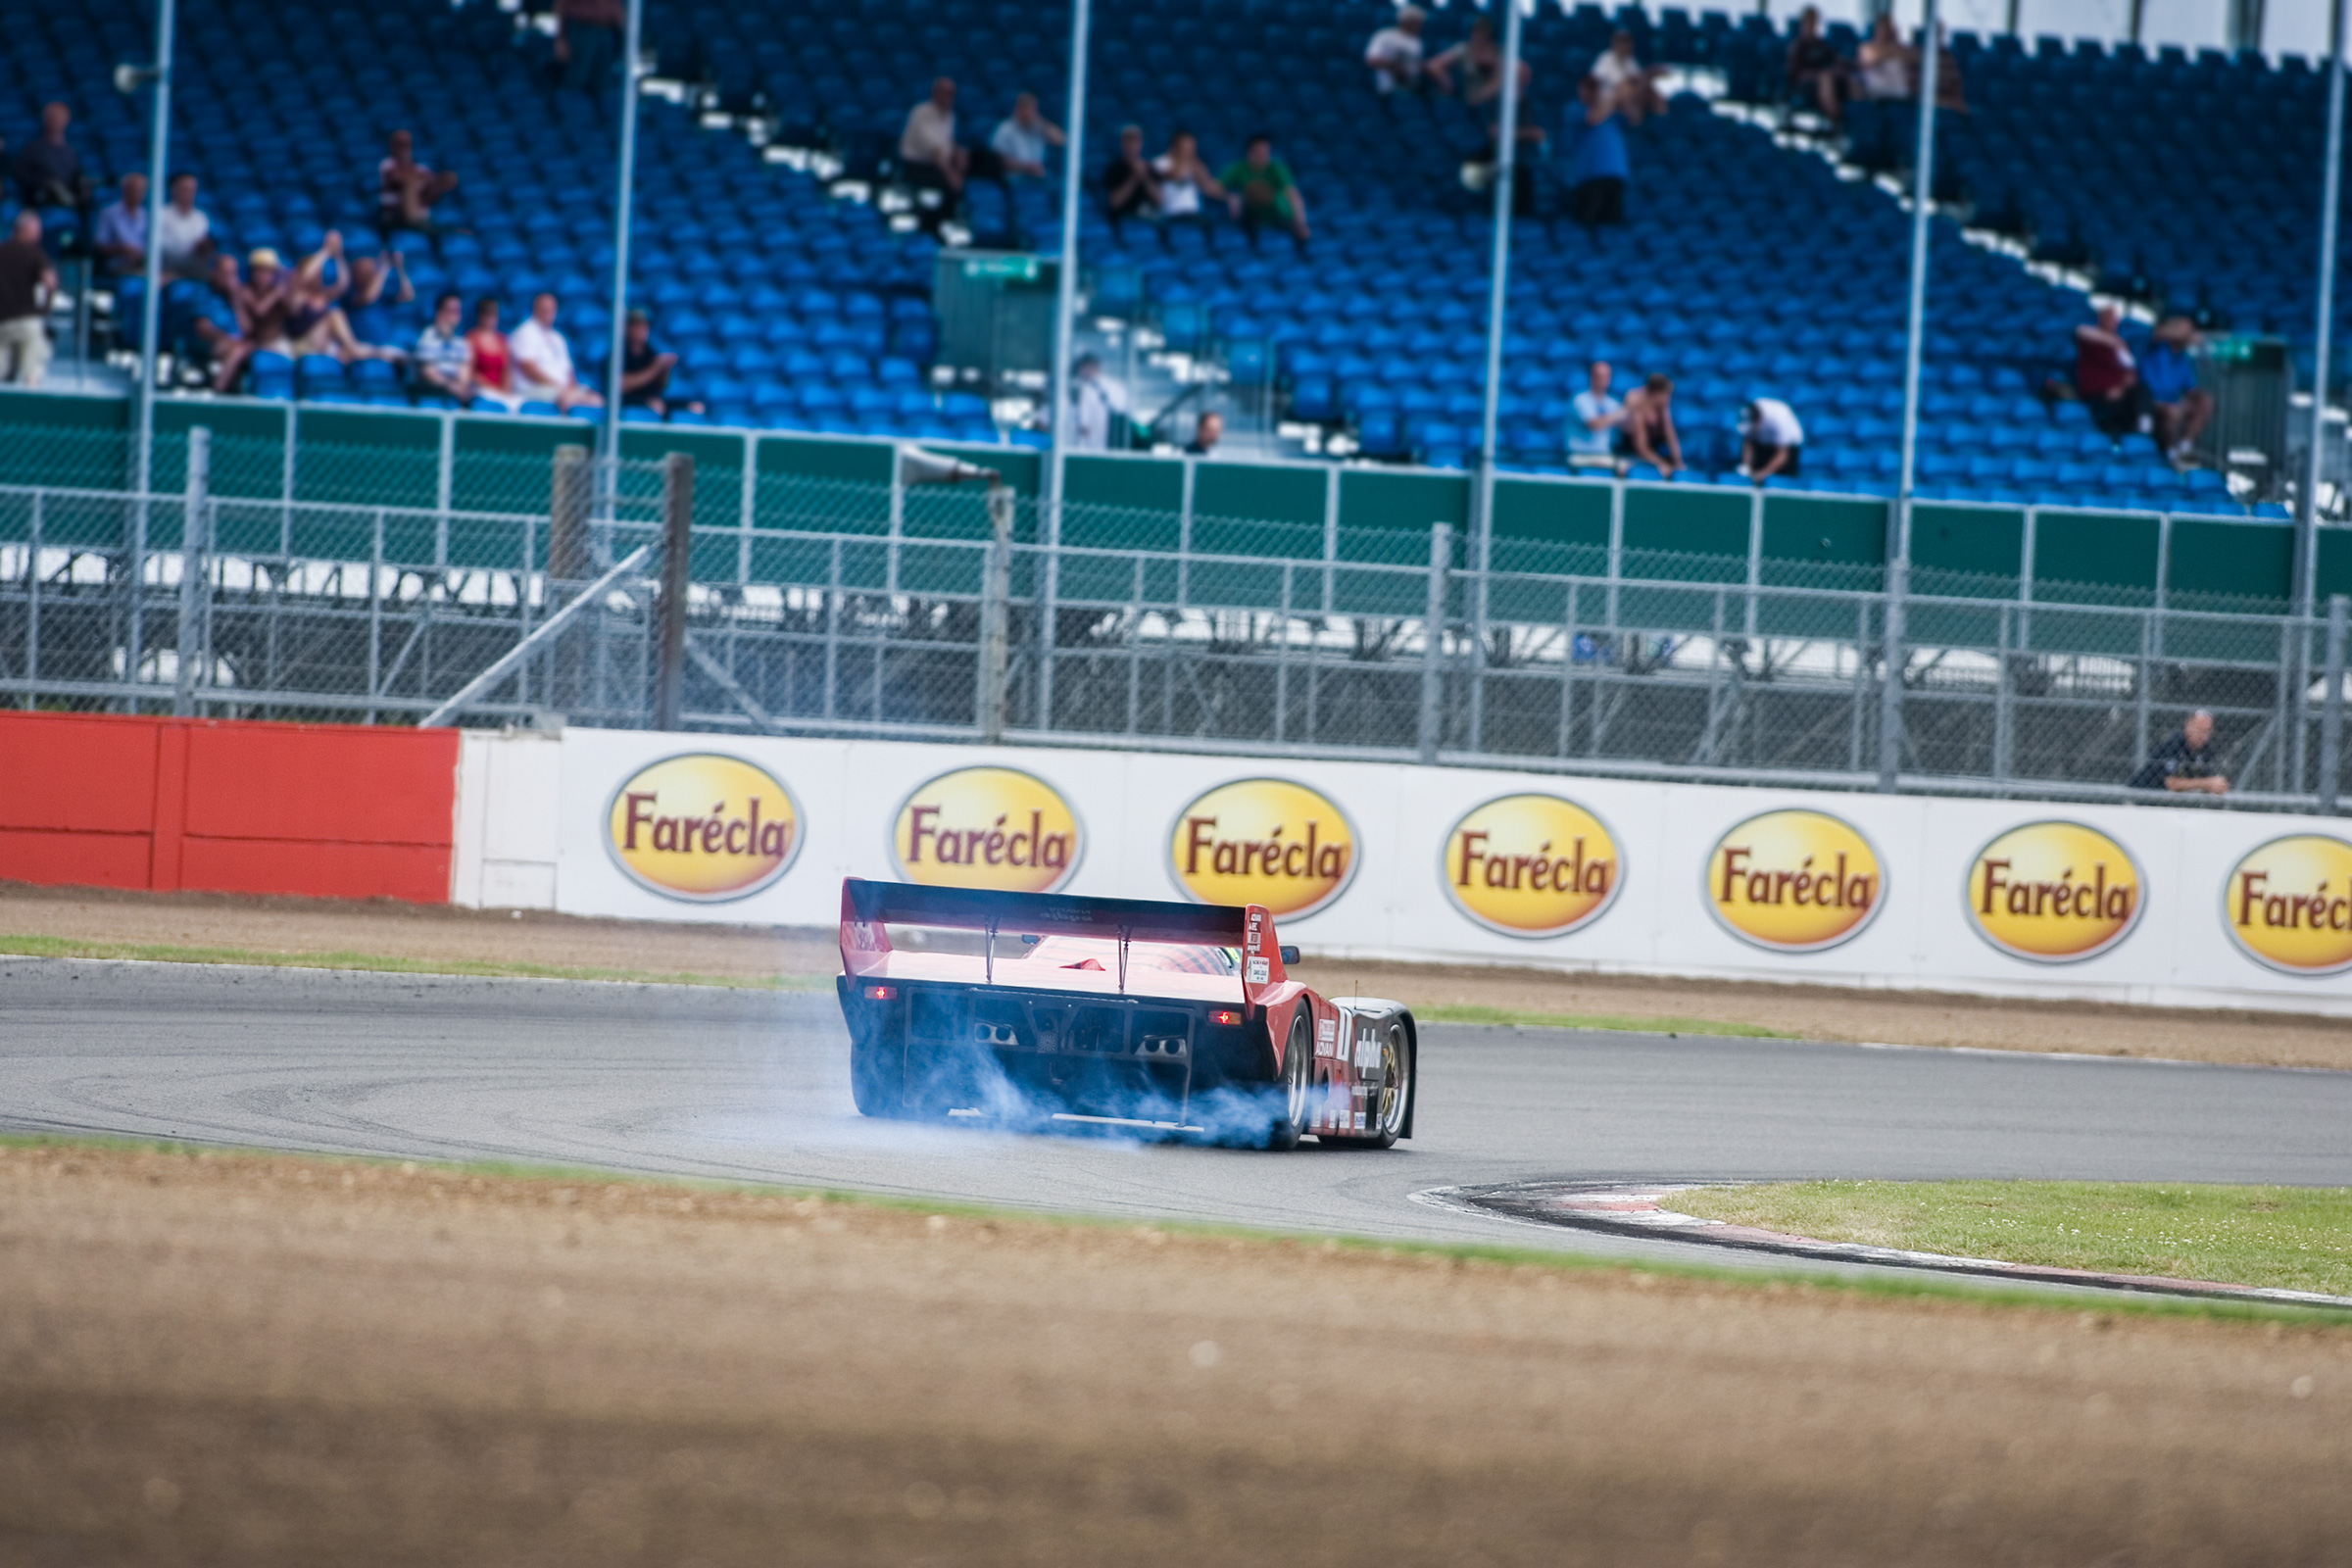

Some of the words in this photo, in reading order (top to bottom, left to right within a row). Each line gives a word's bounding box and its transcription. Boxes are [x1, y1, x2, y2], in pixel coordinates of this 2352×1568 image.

[622, 792, 787, 858] Farécla
[908, 805, 1069, 869] Farécla
[1184, 816, 1348, 881] Farécla
[1456, 829, 1611, 898] Farécla
[1719, 846, 1874, 911] Farécla
[1980, 858, 2132, 923] Farécla
[2238, 870, 2352, 931] Faréc
[1314, 1041, 1334, 1056] ADVAN
